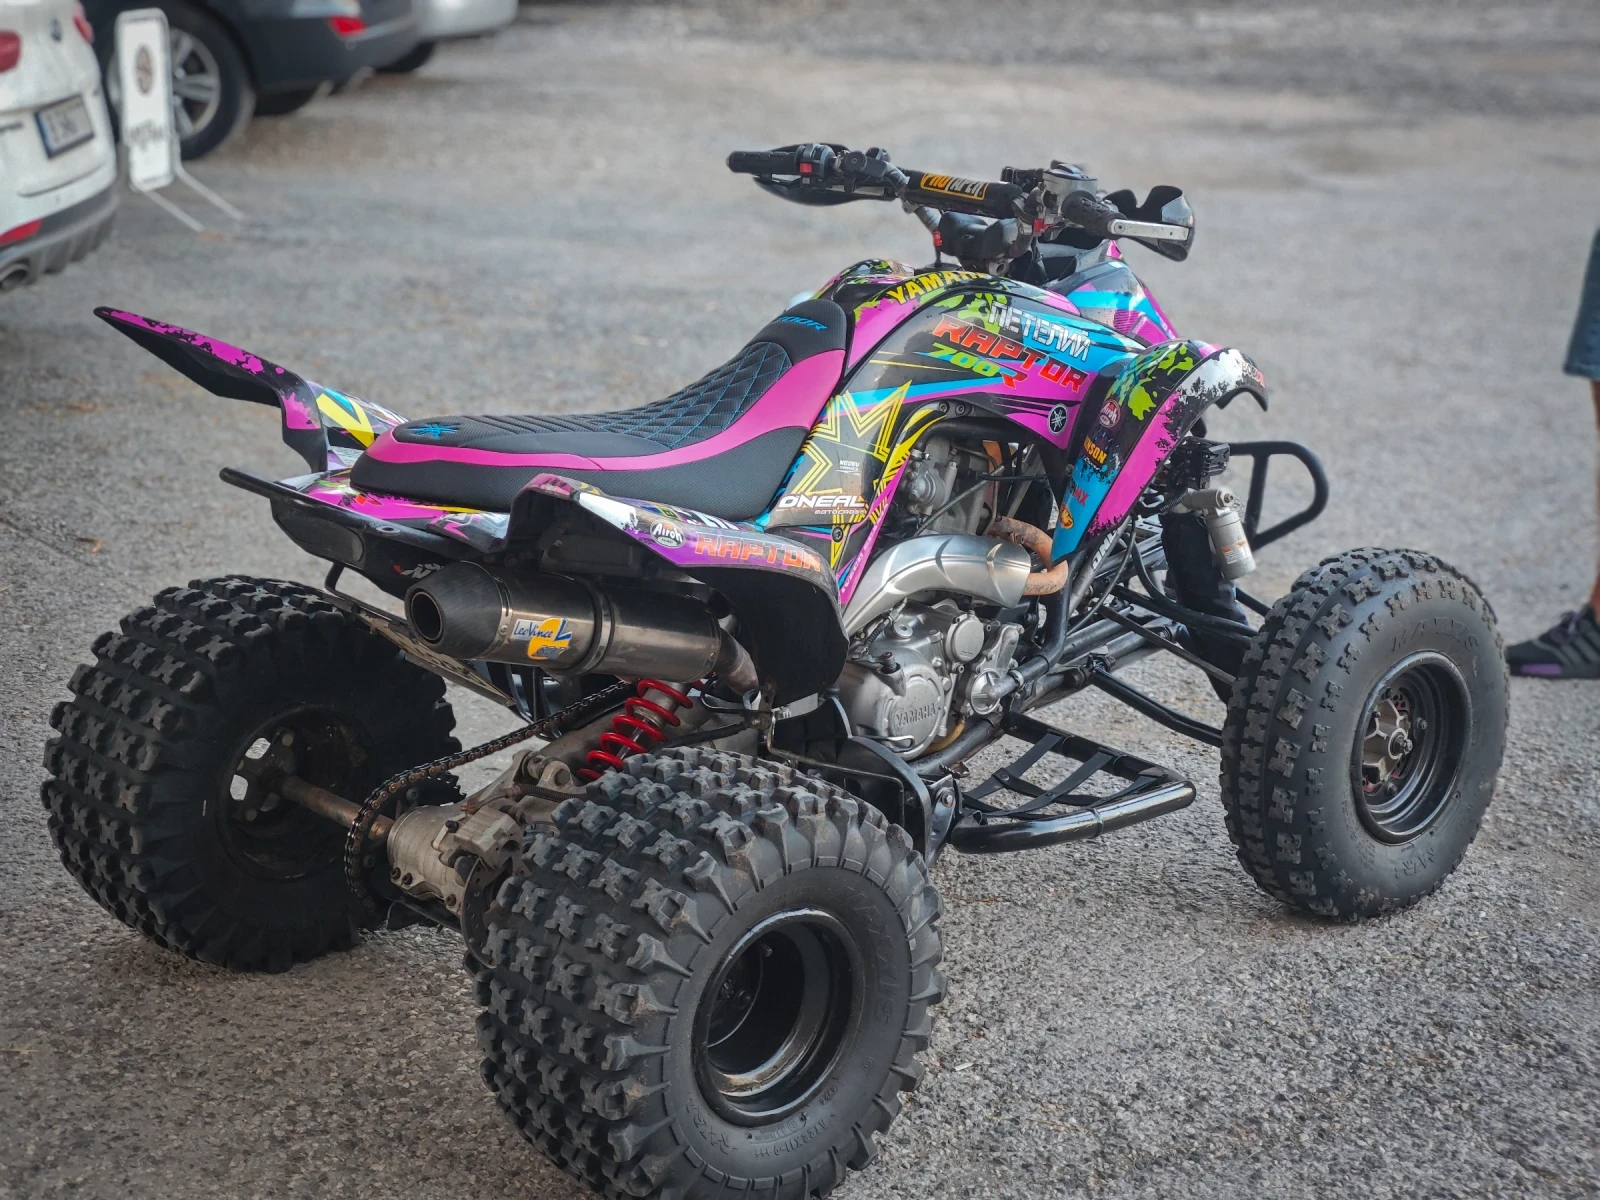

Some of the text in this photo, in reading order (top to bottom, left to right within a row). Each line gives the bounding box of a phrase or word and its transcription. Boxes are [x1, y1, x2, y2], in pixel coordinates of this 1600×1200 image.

[931, 342, 1028, 390] 700R
[932, 313, 1089, 393] RAPTOR
[652, 522, 683, 543] Airoh
[695, 531, 821, 572] RAPTOR
[513, 621, 554, 639] LeoVince
[895, 702, 937, 728] YAMAHA
